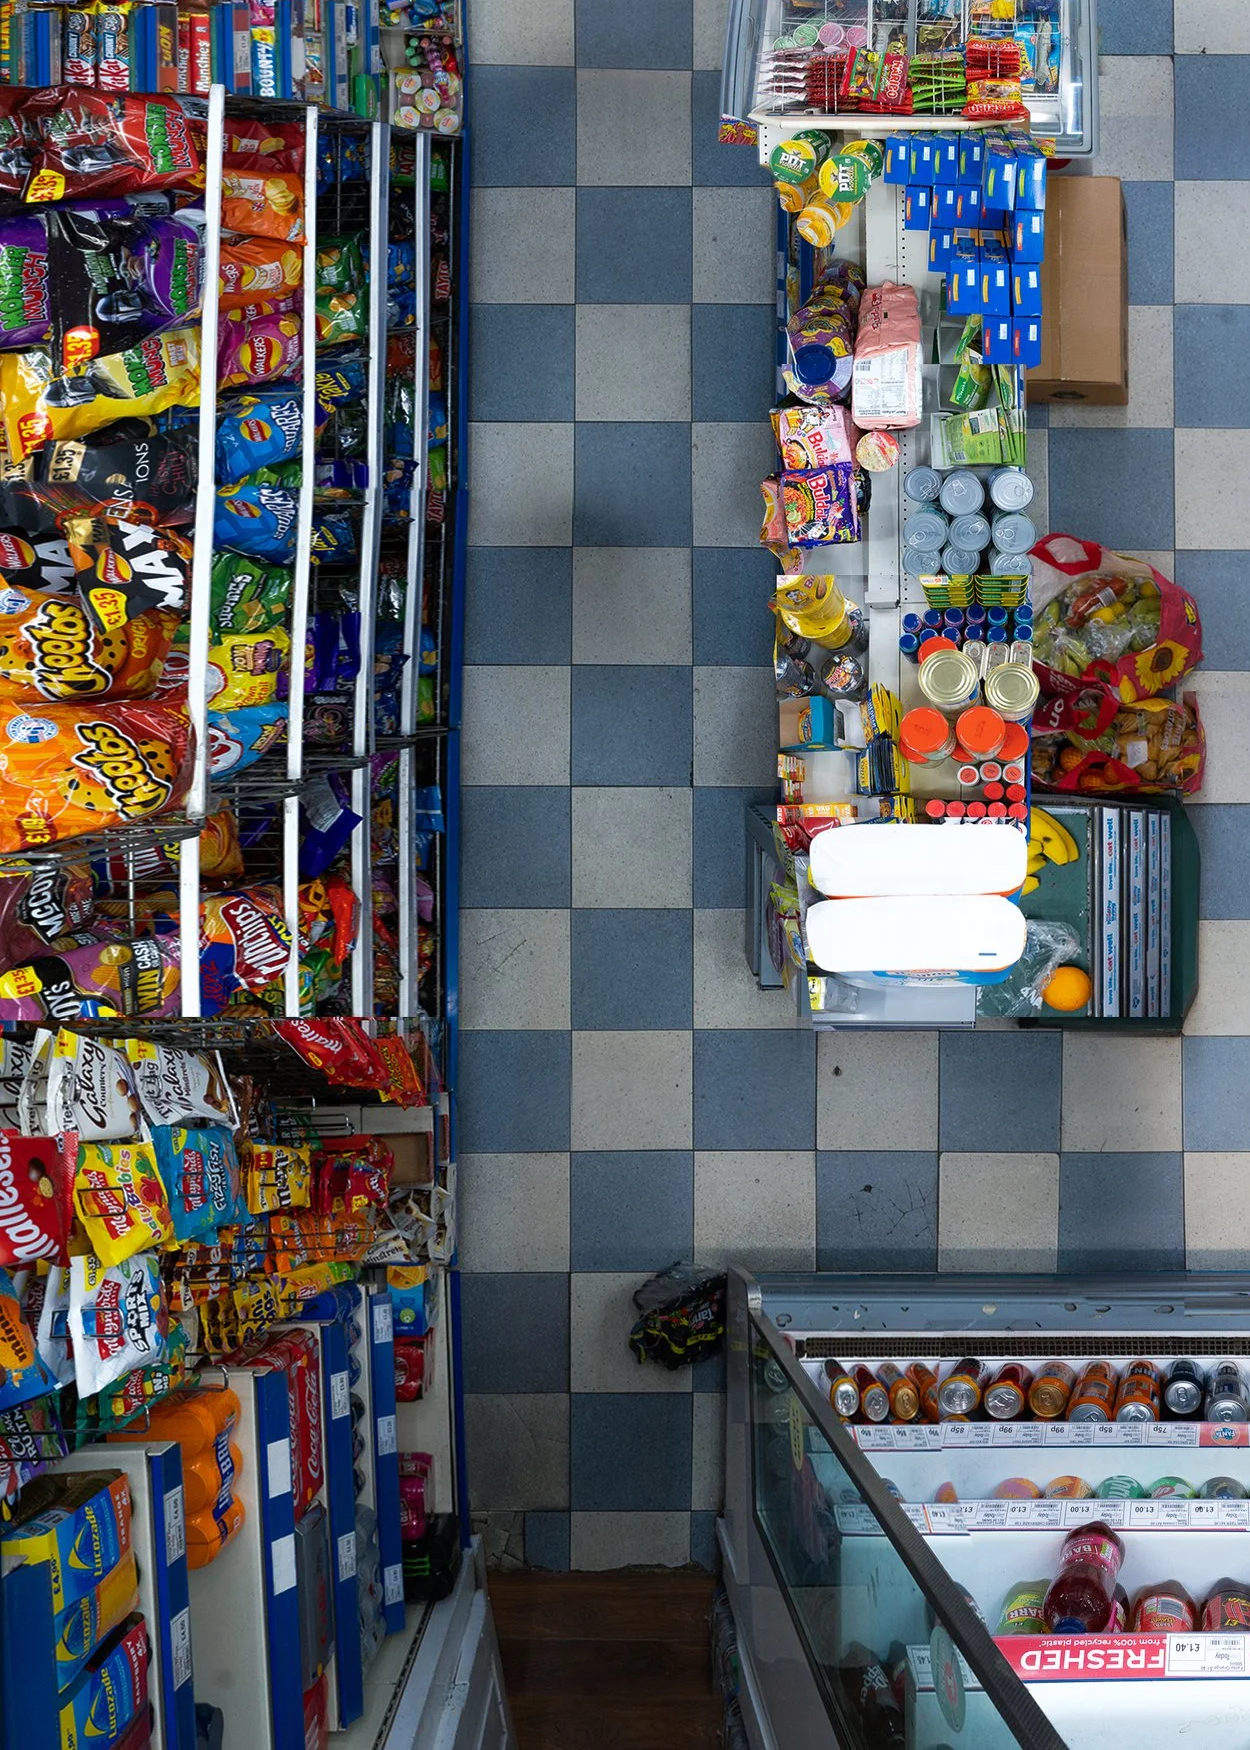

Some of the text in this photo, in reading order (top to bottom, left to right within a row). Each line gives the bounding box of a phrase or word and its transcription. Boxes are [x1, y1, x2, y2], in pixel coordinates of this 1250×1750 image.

[257, 42, 275, 97] BOUNTY
[886, 58, 904, 101] HARIBO
[808, 473, 828, 524] Buldak
[37, 598, 112, 701] Cheetos
[74, 722, 171, 820] Cheetos
[77, 1040, 108, 1130] Galaxy
[1074, 1639, 1111, 1649] recycled
[1175, 1641, 1201, 1653] £1.40
[99, 1667, 118, 1740] Lucozade
